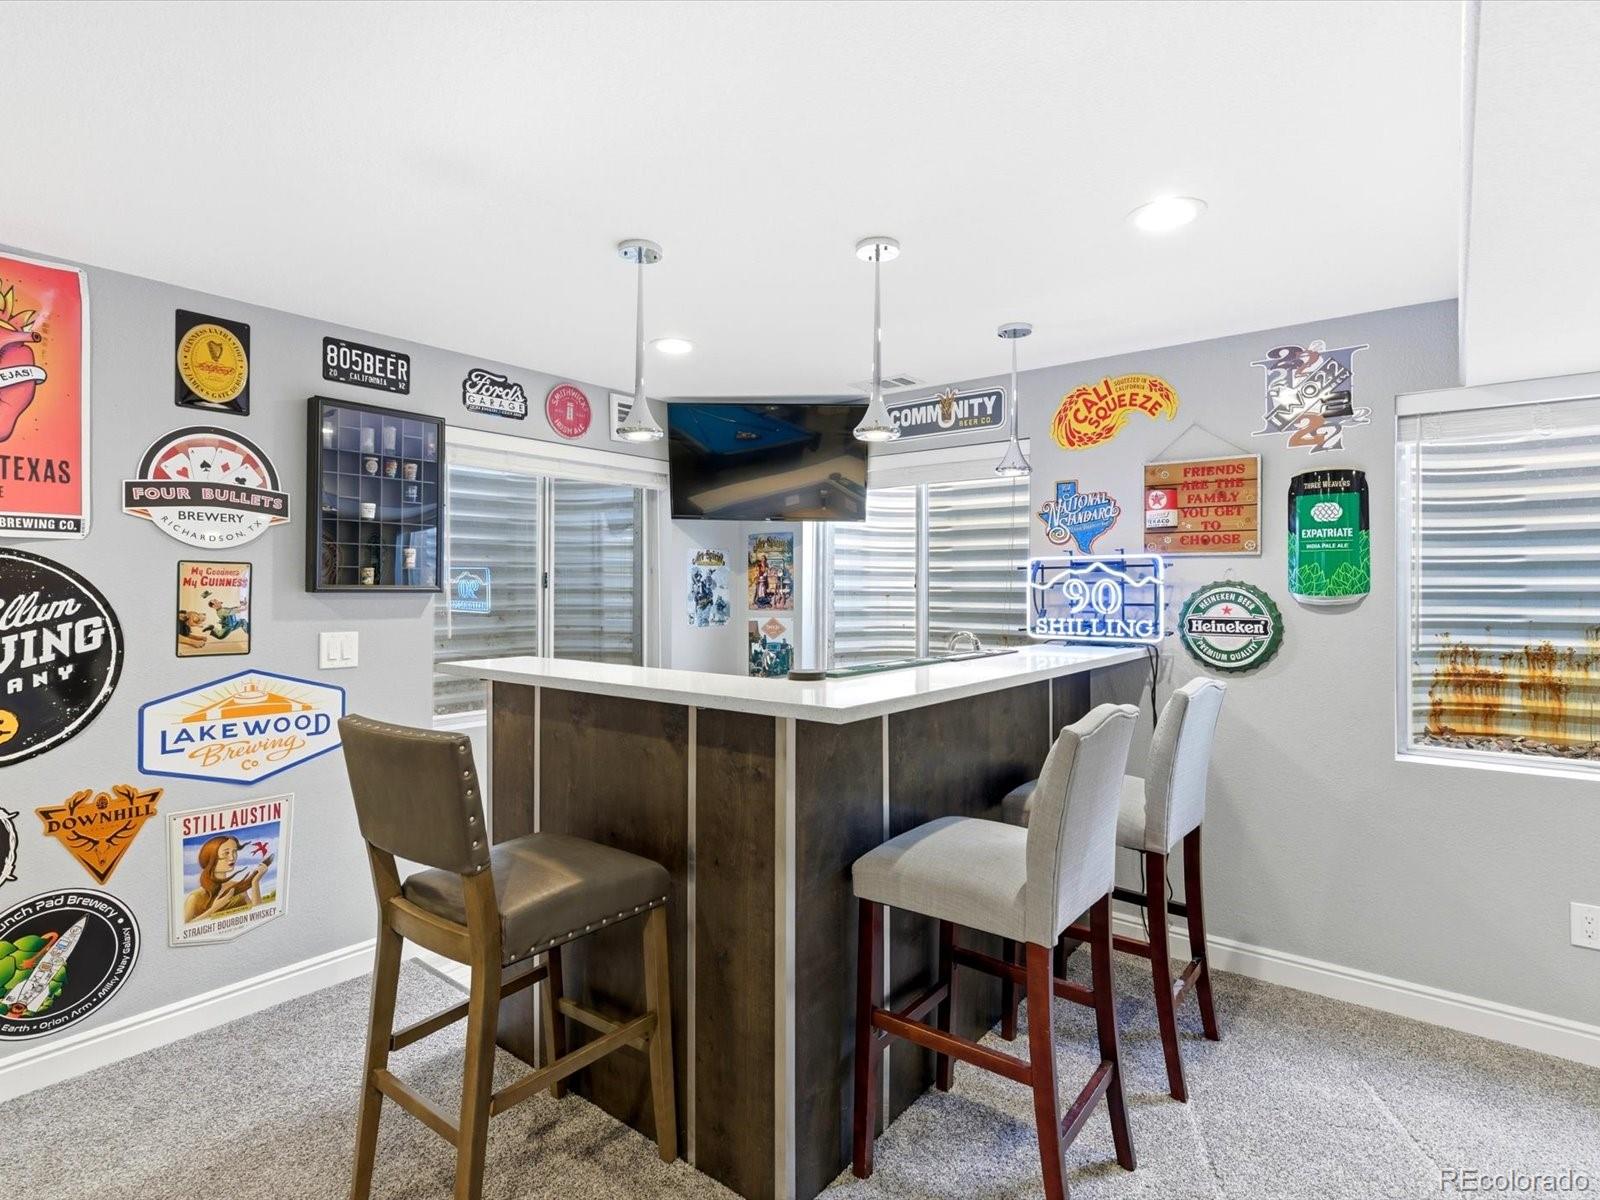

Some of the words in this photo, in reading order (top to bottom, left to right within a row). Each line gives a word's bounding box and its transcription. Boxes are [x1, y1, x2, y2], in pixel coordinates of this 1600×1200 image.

[183, 328, 207, 353] GUINNESS
[208, 327, 232, 342] EXTRA
[329, 368, 338, 377] 20
[349, 372, 388, 386] CALIFORNIA
[211, 389, 230, 399] GATE
[466, 371, 525, 402] Ford's
[1115, 384, 1145, 392] CALIFORNIA
[467, 394, 525, 413] GARAGE
[1073, 380, 1113, 424] CALI
[890, 395, 997, 429] COMMUNITY
[1088, 392, 1163, 429] SQUEEZE
[959, 418, 978, 427] BEER
[0, 455, 71, 484] TEXAS
[1183, 463, 1246, 478] FRIENDS
[1181, 480, 1209, 491] ARE
[1216, 478, 1245, 488] THE
[1323, 480, 1351, 488] WEAVERS
[132, 487, 191, 500] FOUR
[202, 487, 283, 510] BULLETS
[1187, 491, 1240, 504] FAMILY
[178, 511, 245, 523] BREWERY
[1042, 491, 1109, 532] NATIONAL
[1181, 507, 1209, 518] YOU
[1215, 506, 1245, 516] GET
[0, 517, 55, 529] BREWING
[59, 519, 77, 530] CO.
[248, 519, 263, 532] TX
[1201, 521, 1221, 530] TO
[1180, 534, 1241, 545] CHOOSE
[1301, 527, 1354, 539] EXPATRIATE
[191, 566, 203, 577] My
[205, 567, 240, 576] Goodness
[183, 576, 197, 588] My
[200, 575, 248, 588] GUINNESS
[1063, 578, 1123, 614] 90
[1198, 593, 1236, 610] HEINEKEN
[1237, 595, 1256, 610] BEER
[0, 591, 81, 631] llum
[1036, 617, 1155, 637] SHILLING
[1191, 620, 1264, 633] Heineken
[1196, 640, 1228, 661] PREMIUM
[1230, 642, 1258, 661] QUALITY
[160, 713, 331, 755] LAKEWOOD
[188, 735, 306, 767] Brewing
[241, 759, 259, 771] Co
[48, 803, 154, 834] DOWNHILL
[183, 813, 225, 836] STILL
[230, 802, 282, 828] AUSTIN
[35, 895, 64, 911] Pad
[67, 895, 118, 918] Brewery
[183, 922, 217, 939] STRAIGHT
[217, 915, 248, 931] BOURBON
[249, 906, 277, 922] WHISKEY
[122, 927, 131, 954] Galaxy
[115, 955, 131, 975] Way
[98, 976, 120, 998] Milky
[71, 1002, 93, 1018] Arm
[1, 1023, 30, 1033] Earth
[39, 1016, 69, 1030] Orion
